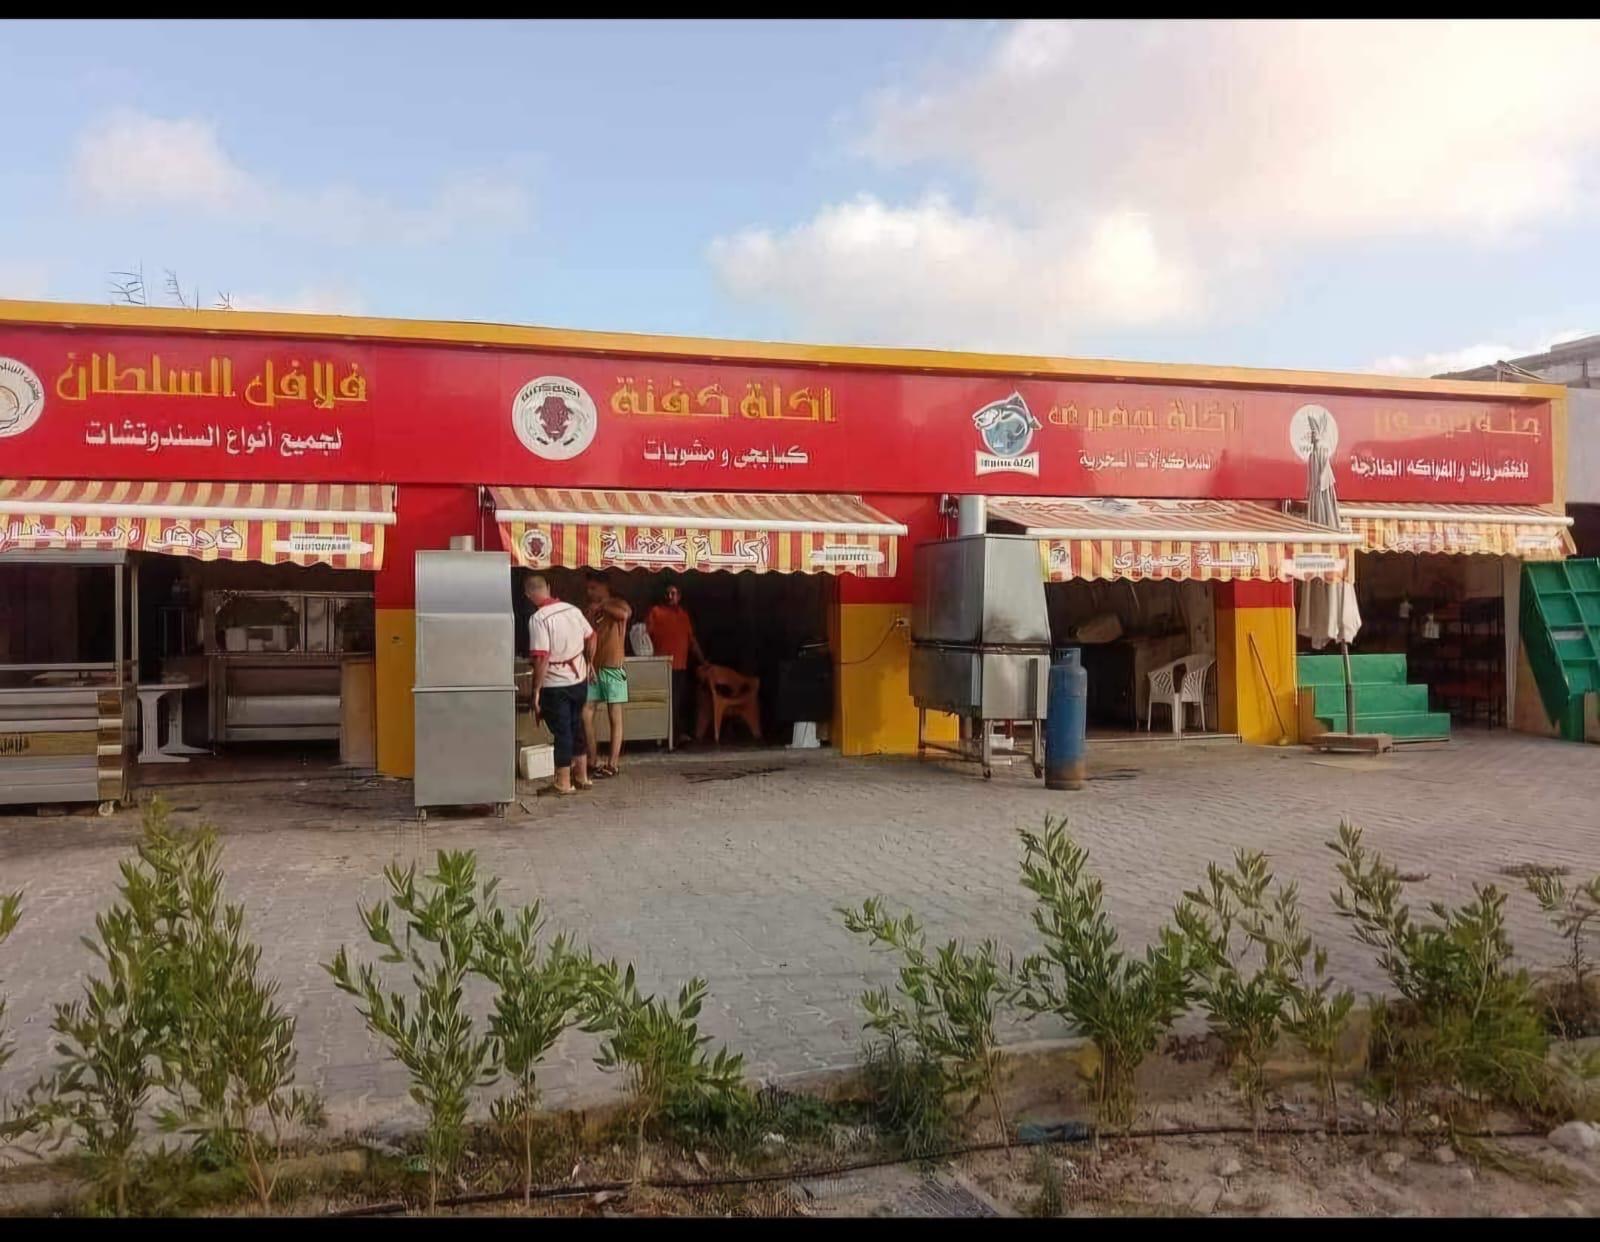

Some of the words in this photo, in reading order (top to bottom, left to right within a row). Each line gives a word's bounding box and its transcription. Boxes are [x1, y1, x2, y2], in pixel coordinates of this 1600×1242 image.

[56, 351, 237, 401] السلطان
[244, 357, 368, 409] فلافل
[85, 418, 221, 453] السندوتشات
[226, 420, 273, 456] أنواع
[280, 426, 343, 457] لجميع
[642, 438, 716, 466] مشويات
